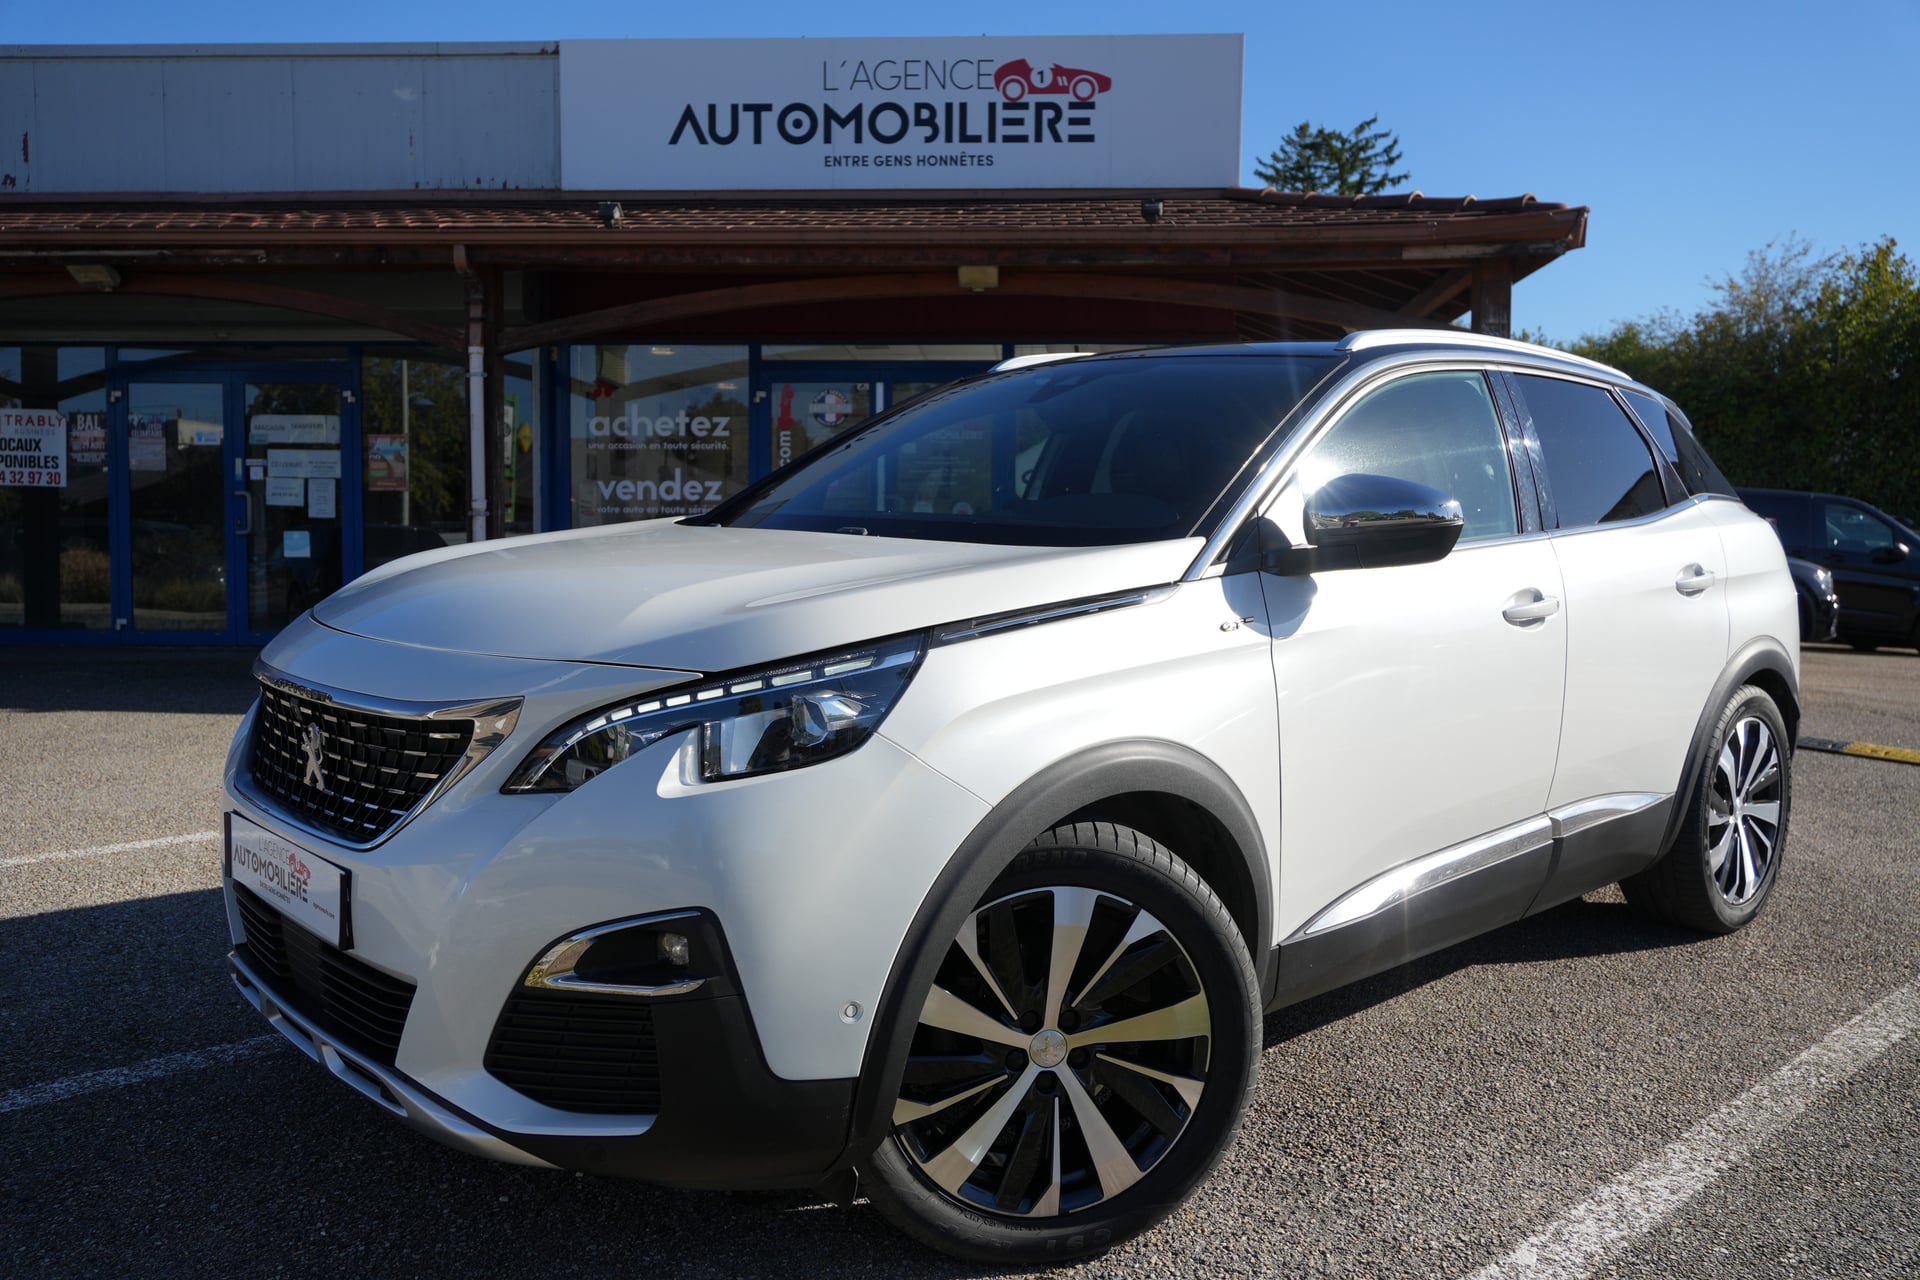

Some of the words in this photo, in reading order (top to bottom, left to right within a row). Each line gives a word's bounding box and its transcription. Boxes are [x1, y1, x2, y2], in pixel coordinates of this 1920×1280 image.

[822, 58, 995, 92] L'AGENCE
[824, 155, 869, 168] ENTRE
[873, 155, 912, 168] GENS
[916, 151, 994, 168] HONNÊTES
[4, 414, 64, 427] TRABLY
[76, 414, 101, 431] BAL
[588, 404, 731, 438] achetez
[15, 428, 56, 436] BUSINESS
[663, 442, 689, 450] toute
[10, 471, 24, 484] 32
[28, 471, 42, 485] 97
[46, 471, 61, 485] 30
[597, 467, 724, 501] vendez
[623, 505, 645, 513] auto
[646, 506, 659, 514] en
[661, 505, 686, 513] toute
